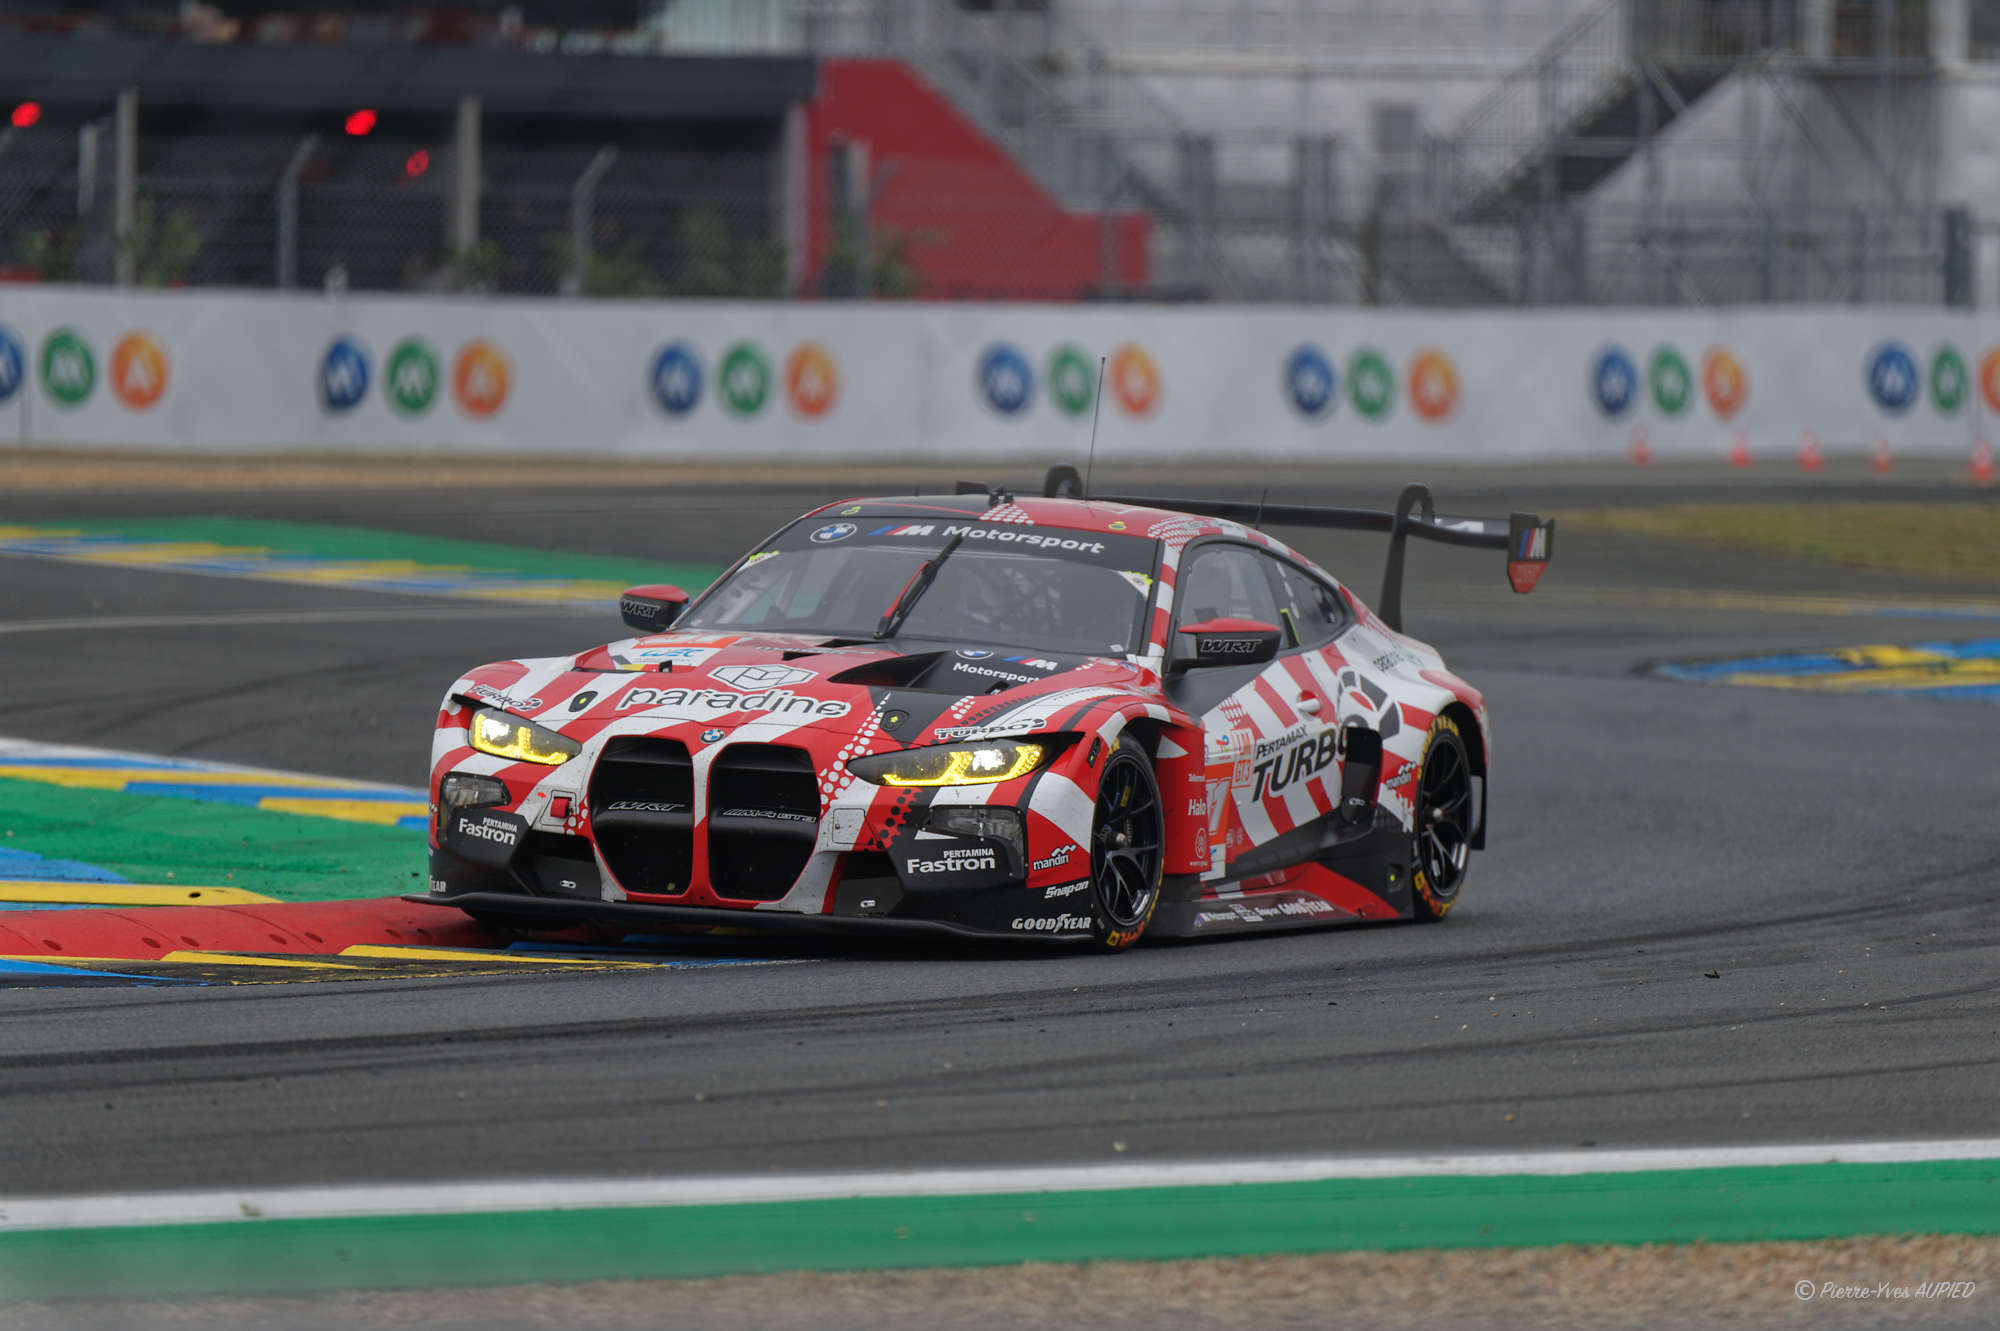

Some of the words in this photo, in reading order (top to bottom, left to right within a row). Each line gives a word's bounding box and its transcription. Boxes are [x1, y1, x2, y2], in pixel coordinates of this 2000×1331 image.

[942, 525, 1105, 554] Motorsport
[1200, 638, 1263, 653] WRT
[618, 688, 848, 717] paradine
[1256, 723, 1309, 760] PERTAMAX
[458, 817, 516, 846] Fastron
[482, 817, 518, 833] PERTAMINA
[943, 848, 994, 858] PERTAMINA
[906, 857, 995, 874] Fastron
[1045, 880, 1089, 899] Snap-on
[1011, 913, 1092, 933] GOODYEAR
